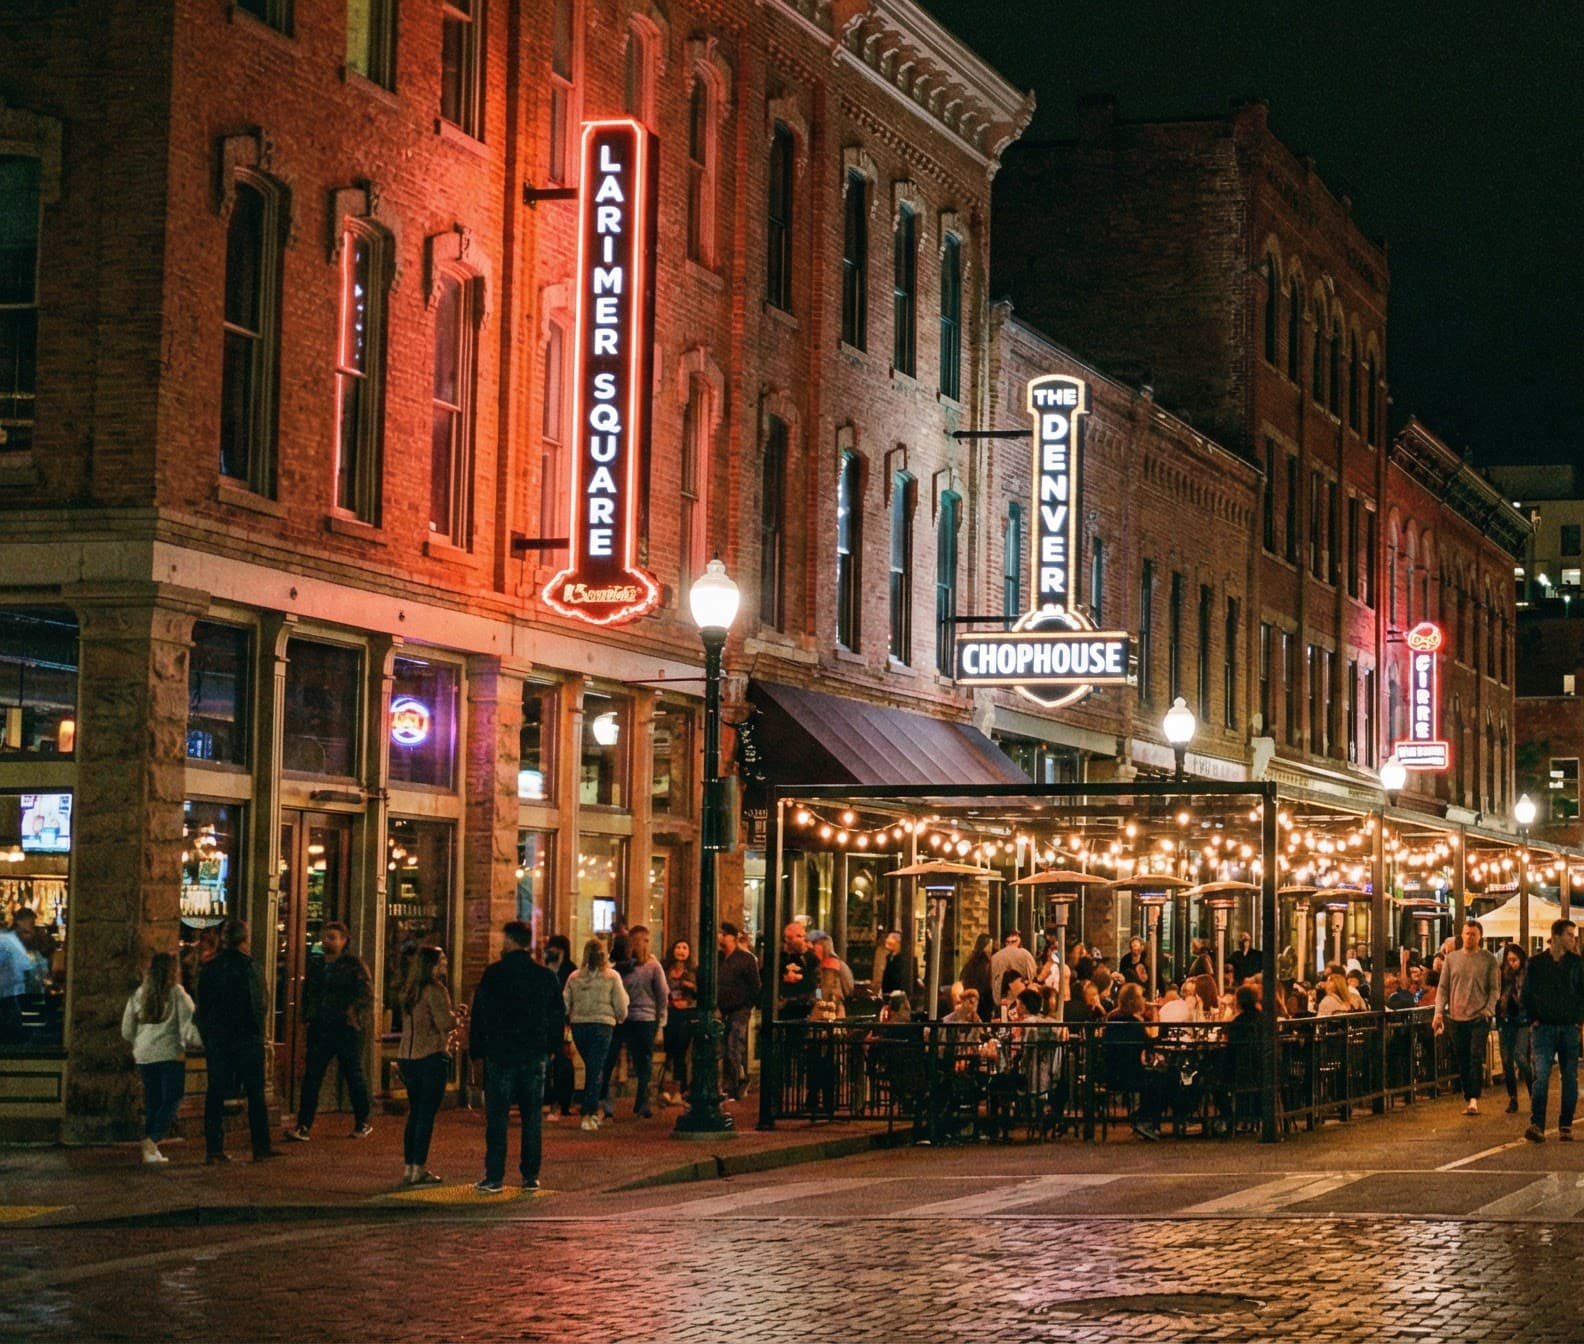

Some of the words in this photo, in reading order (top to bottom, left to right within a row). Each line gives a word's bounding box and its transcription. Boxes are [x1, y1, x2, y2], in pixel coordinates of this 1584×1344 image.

[594, 145, 624, 355] LARIMER
[588, 373, 622, 556] SQUARE
[1035, 390, 1077, 405] THE
[1040, 414, 1069, 593] DENVER
[962, 642, 1122, 675] CHOPHOUSE
